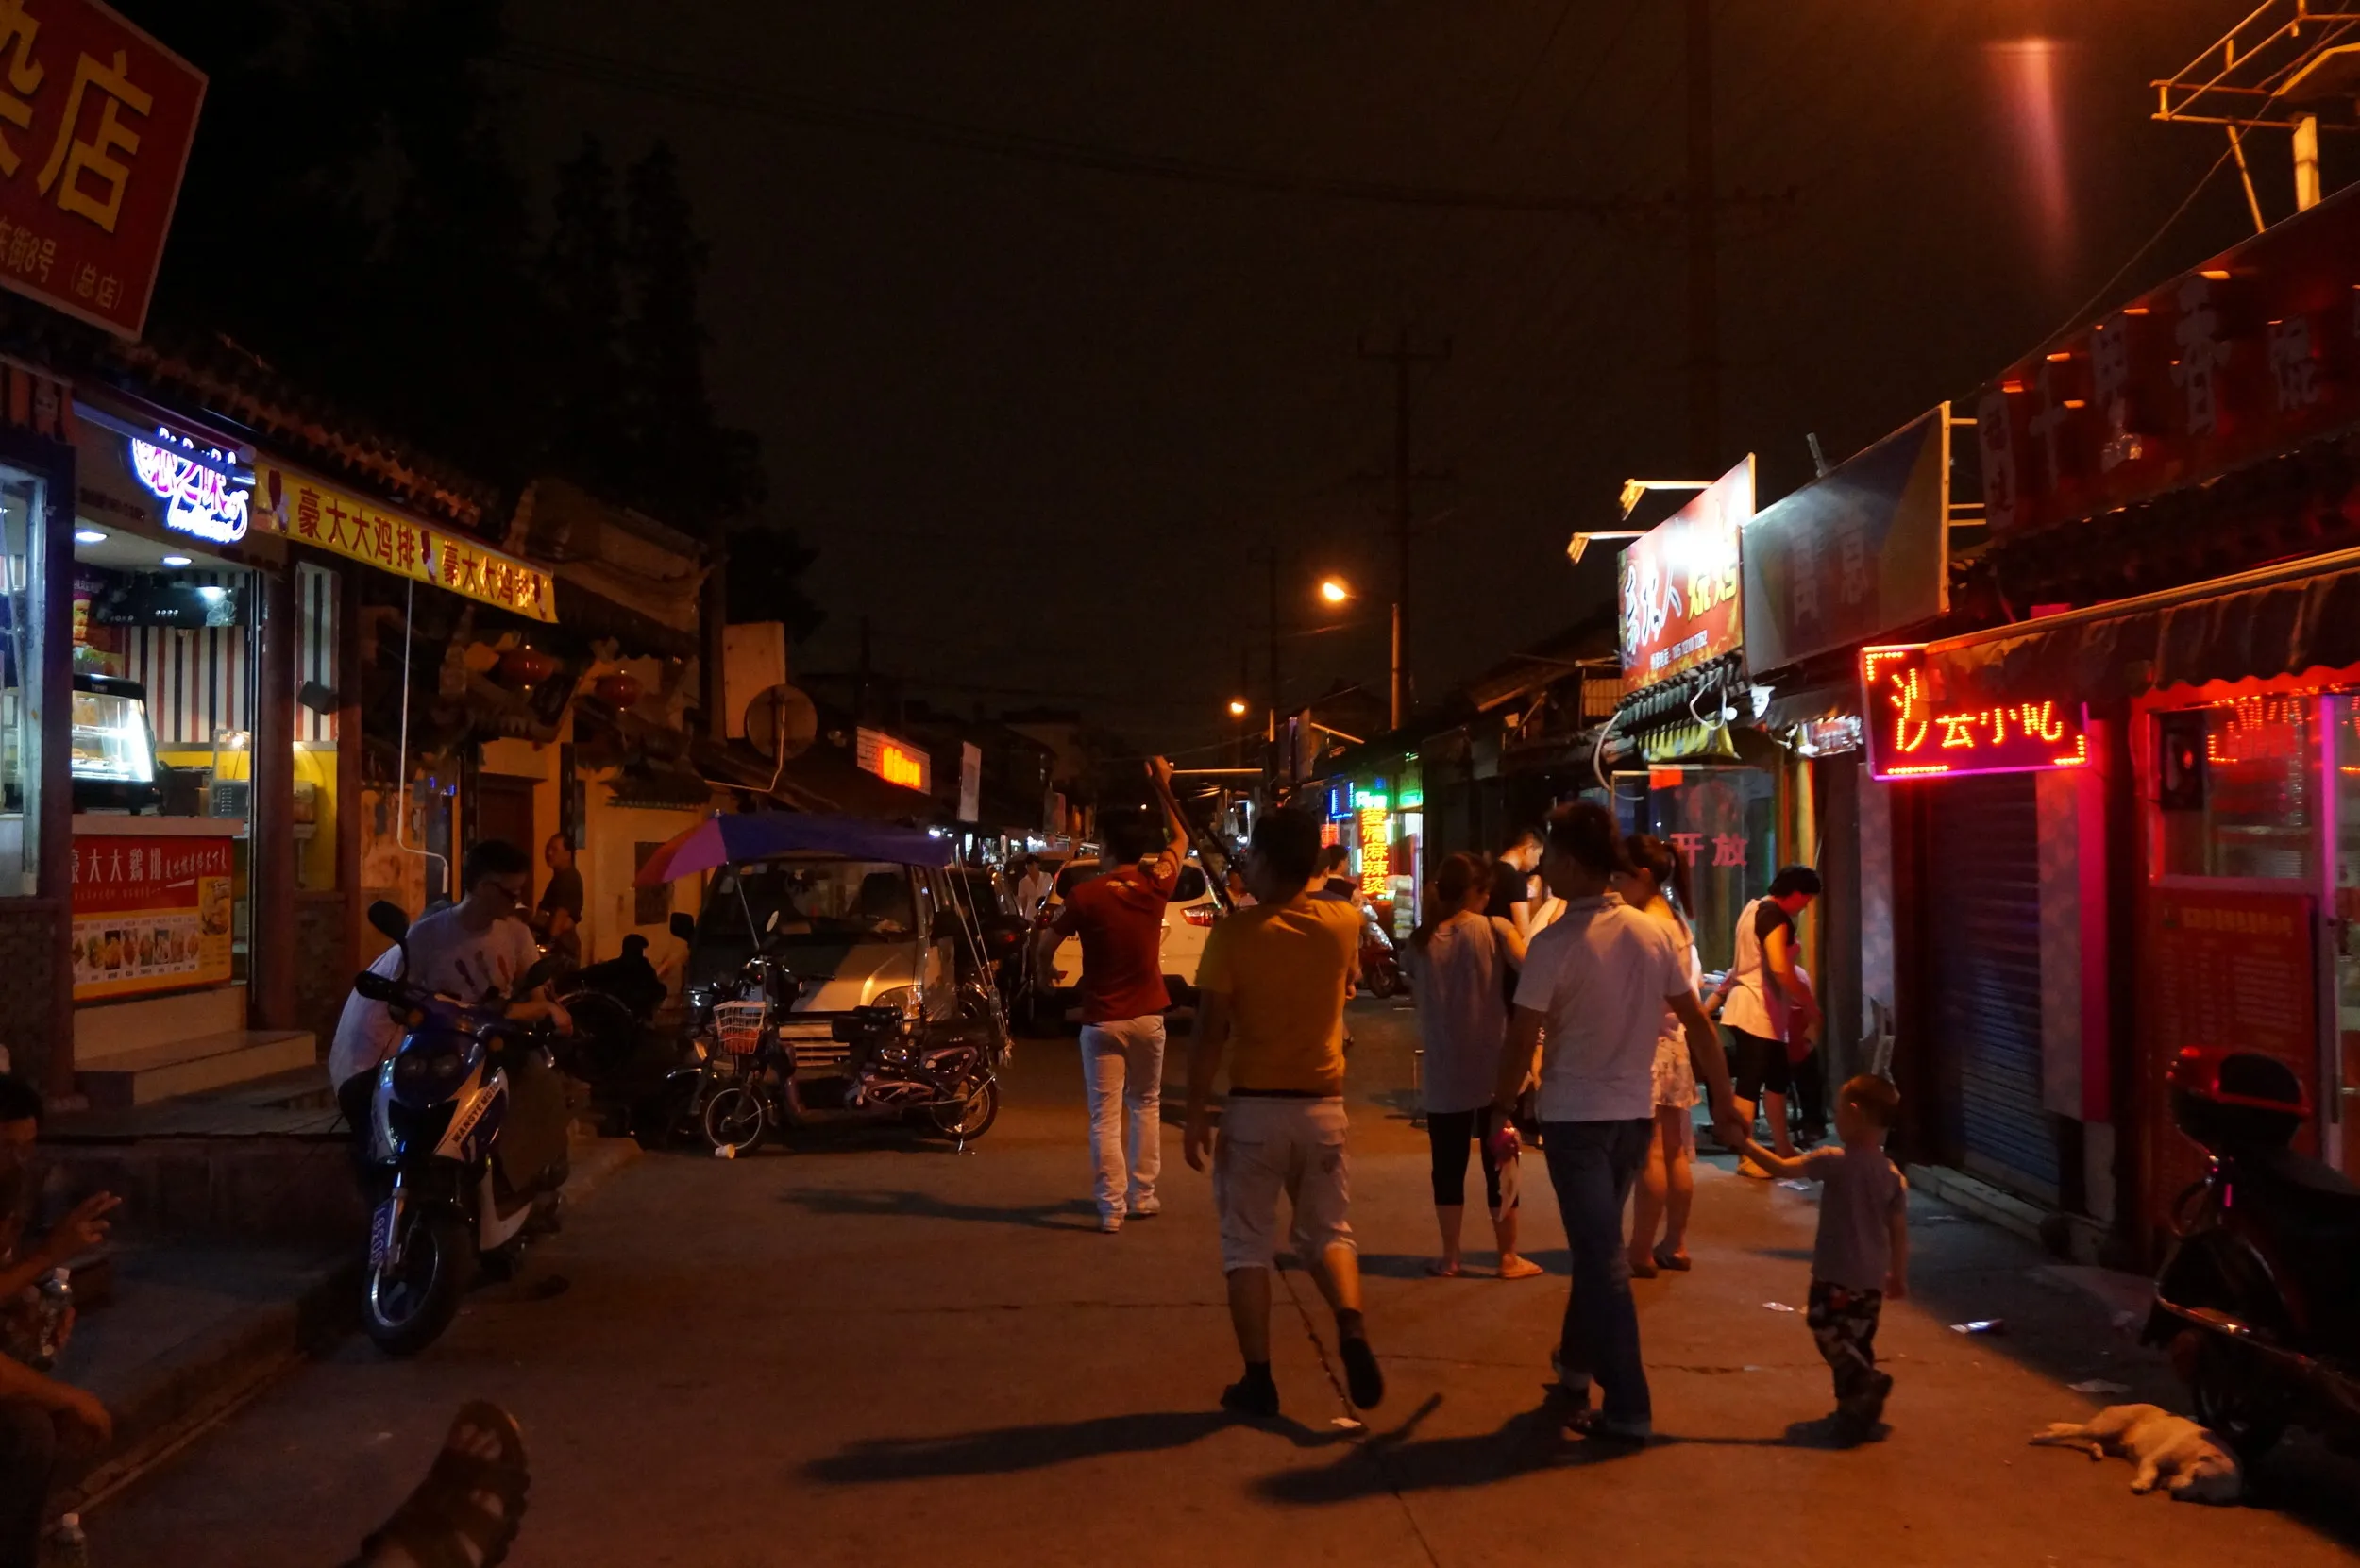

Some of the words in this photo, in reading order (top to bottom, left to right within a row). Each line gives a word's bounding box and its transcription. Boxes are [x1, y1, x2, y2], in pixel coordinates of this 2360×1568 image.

[297, 487, 416, 572] 豪大大鸡排
